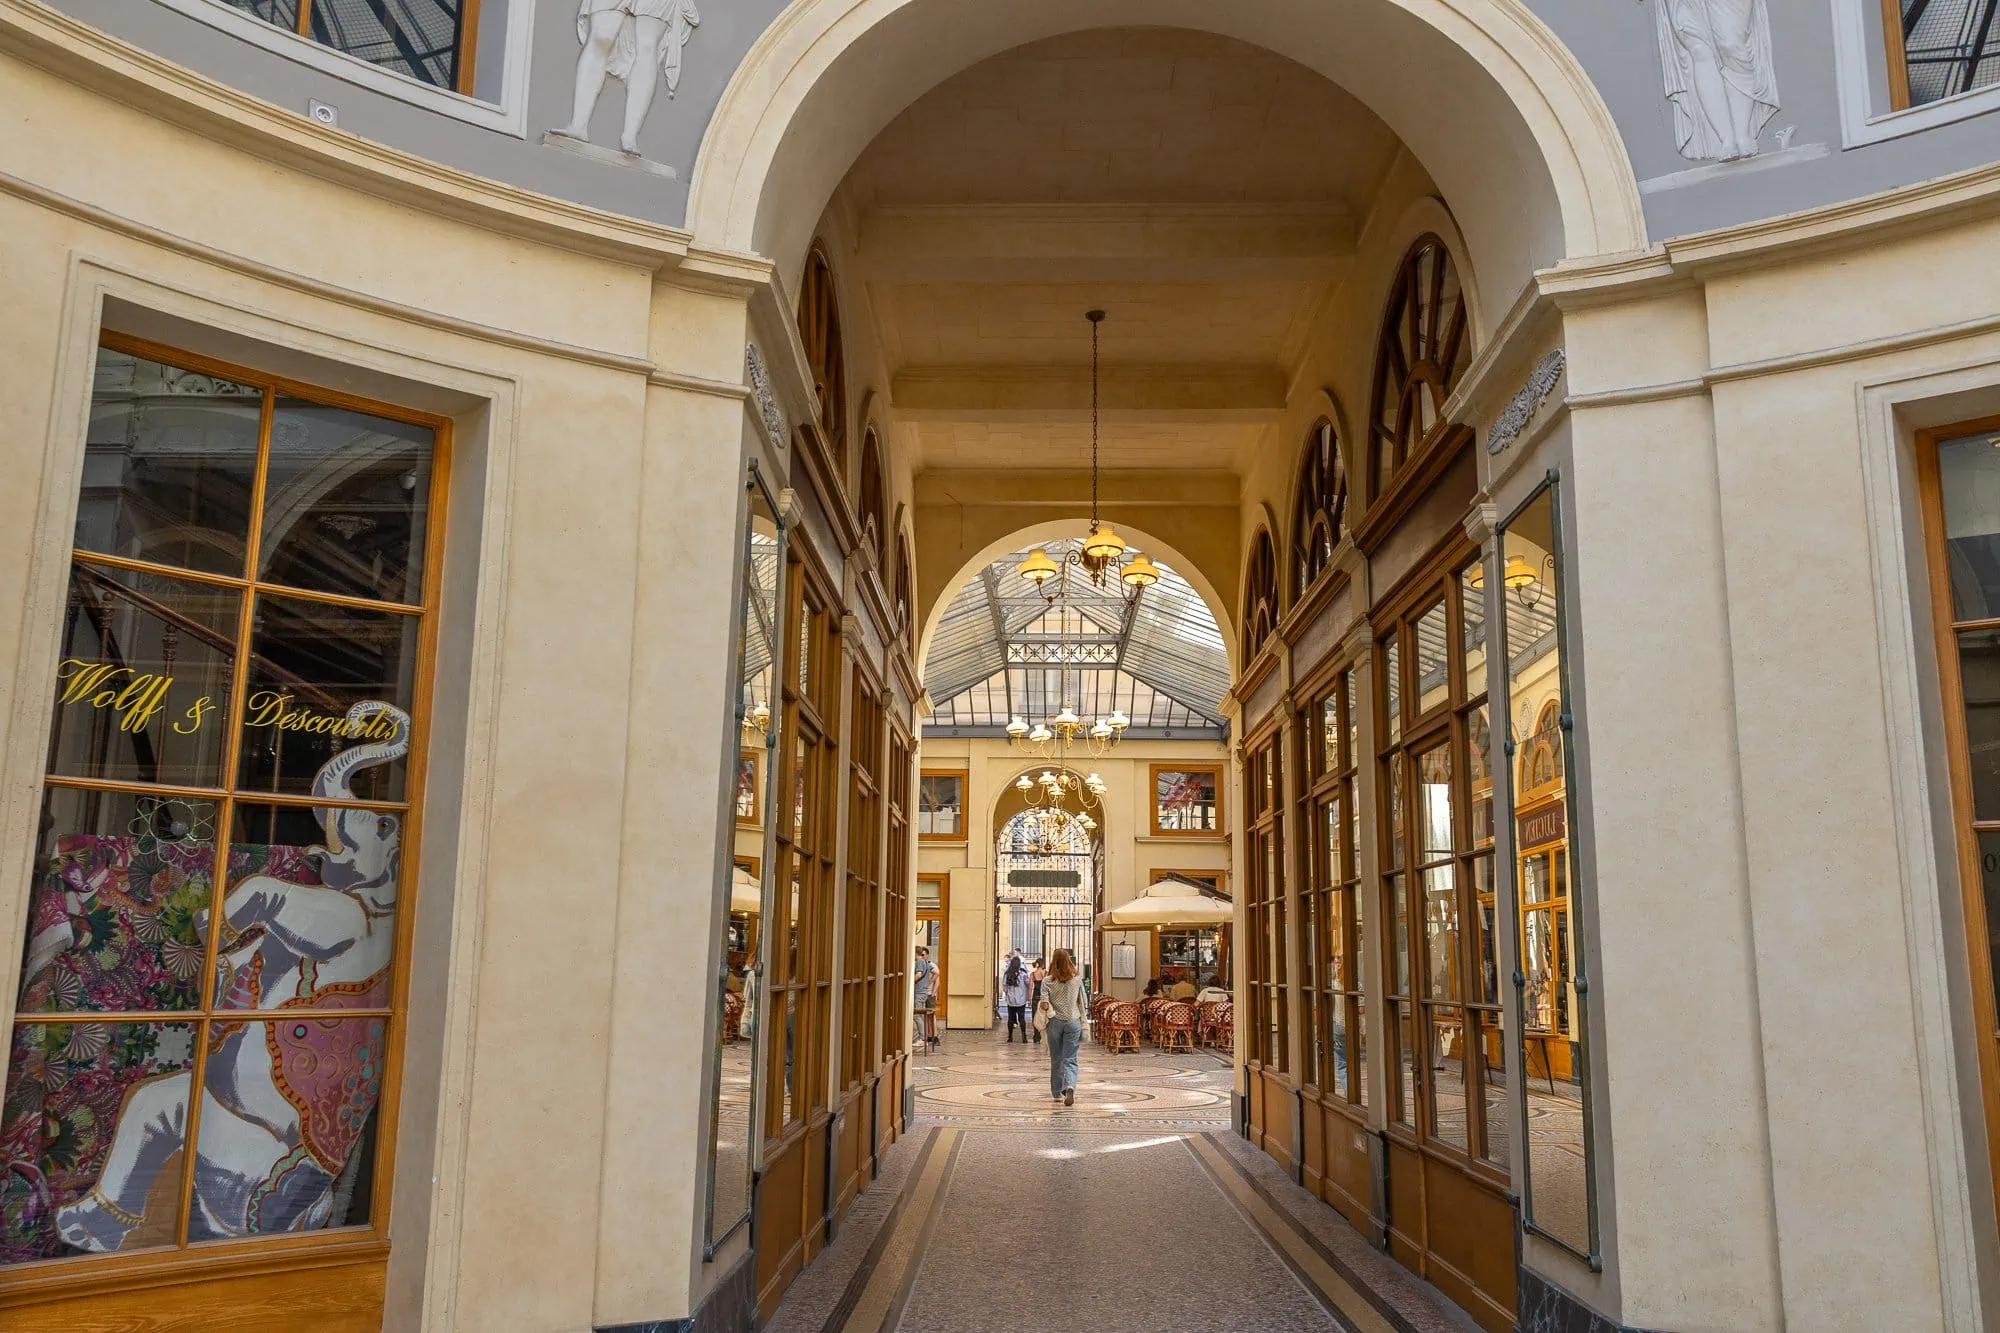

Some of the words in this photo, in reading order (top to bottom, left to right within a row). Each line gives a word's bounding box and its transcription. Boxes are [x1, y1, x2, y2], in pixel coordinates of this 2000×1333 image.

[57, 659, 174, 733] Wolff
[173, 696, 217, 734] &
[245, 691, 400, 740] Descourtis
